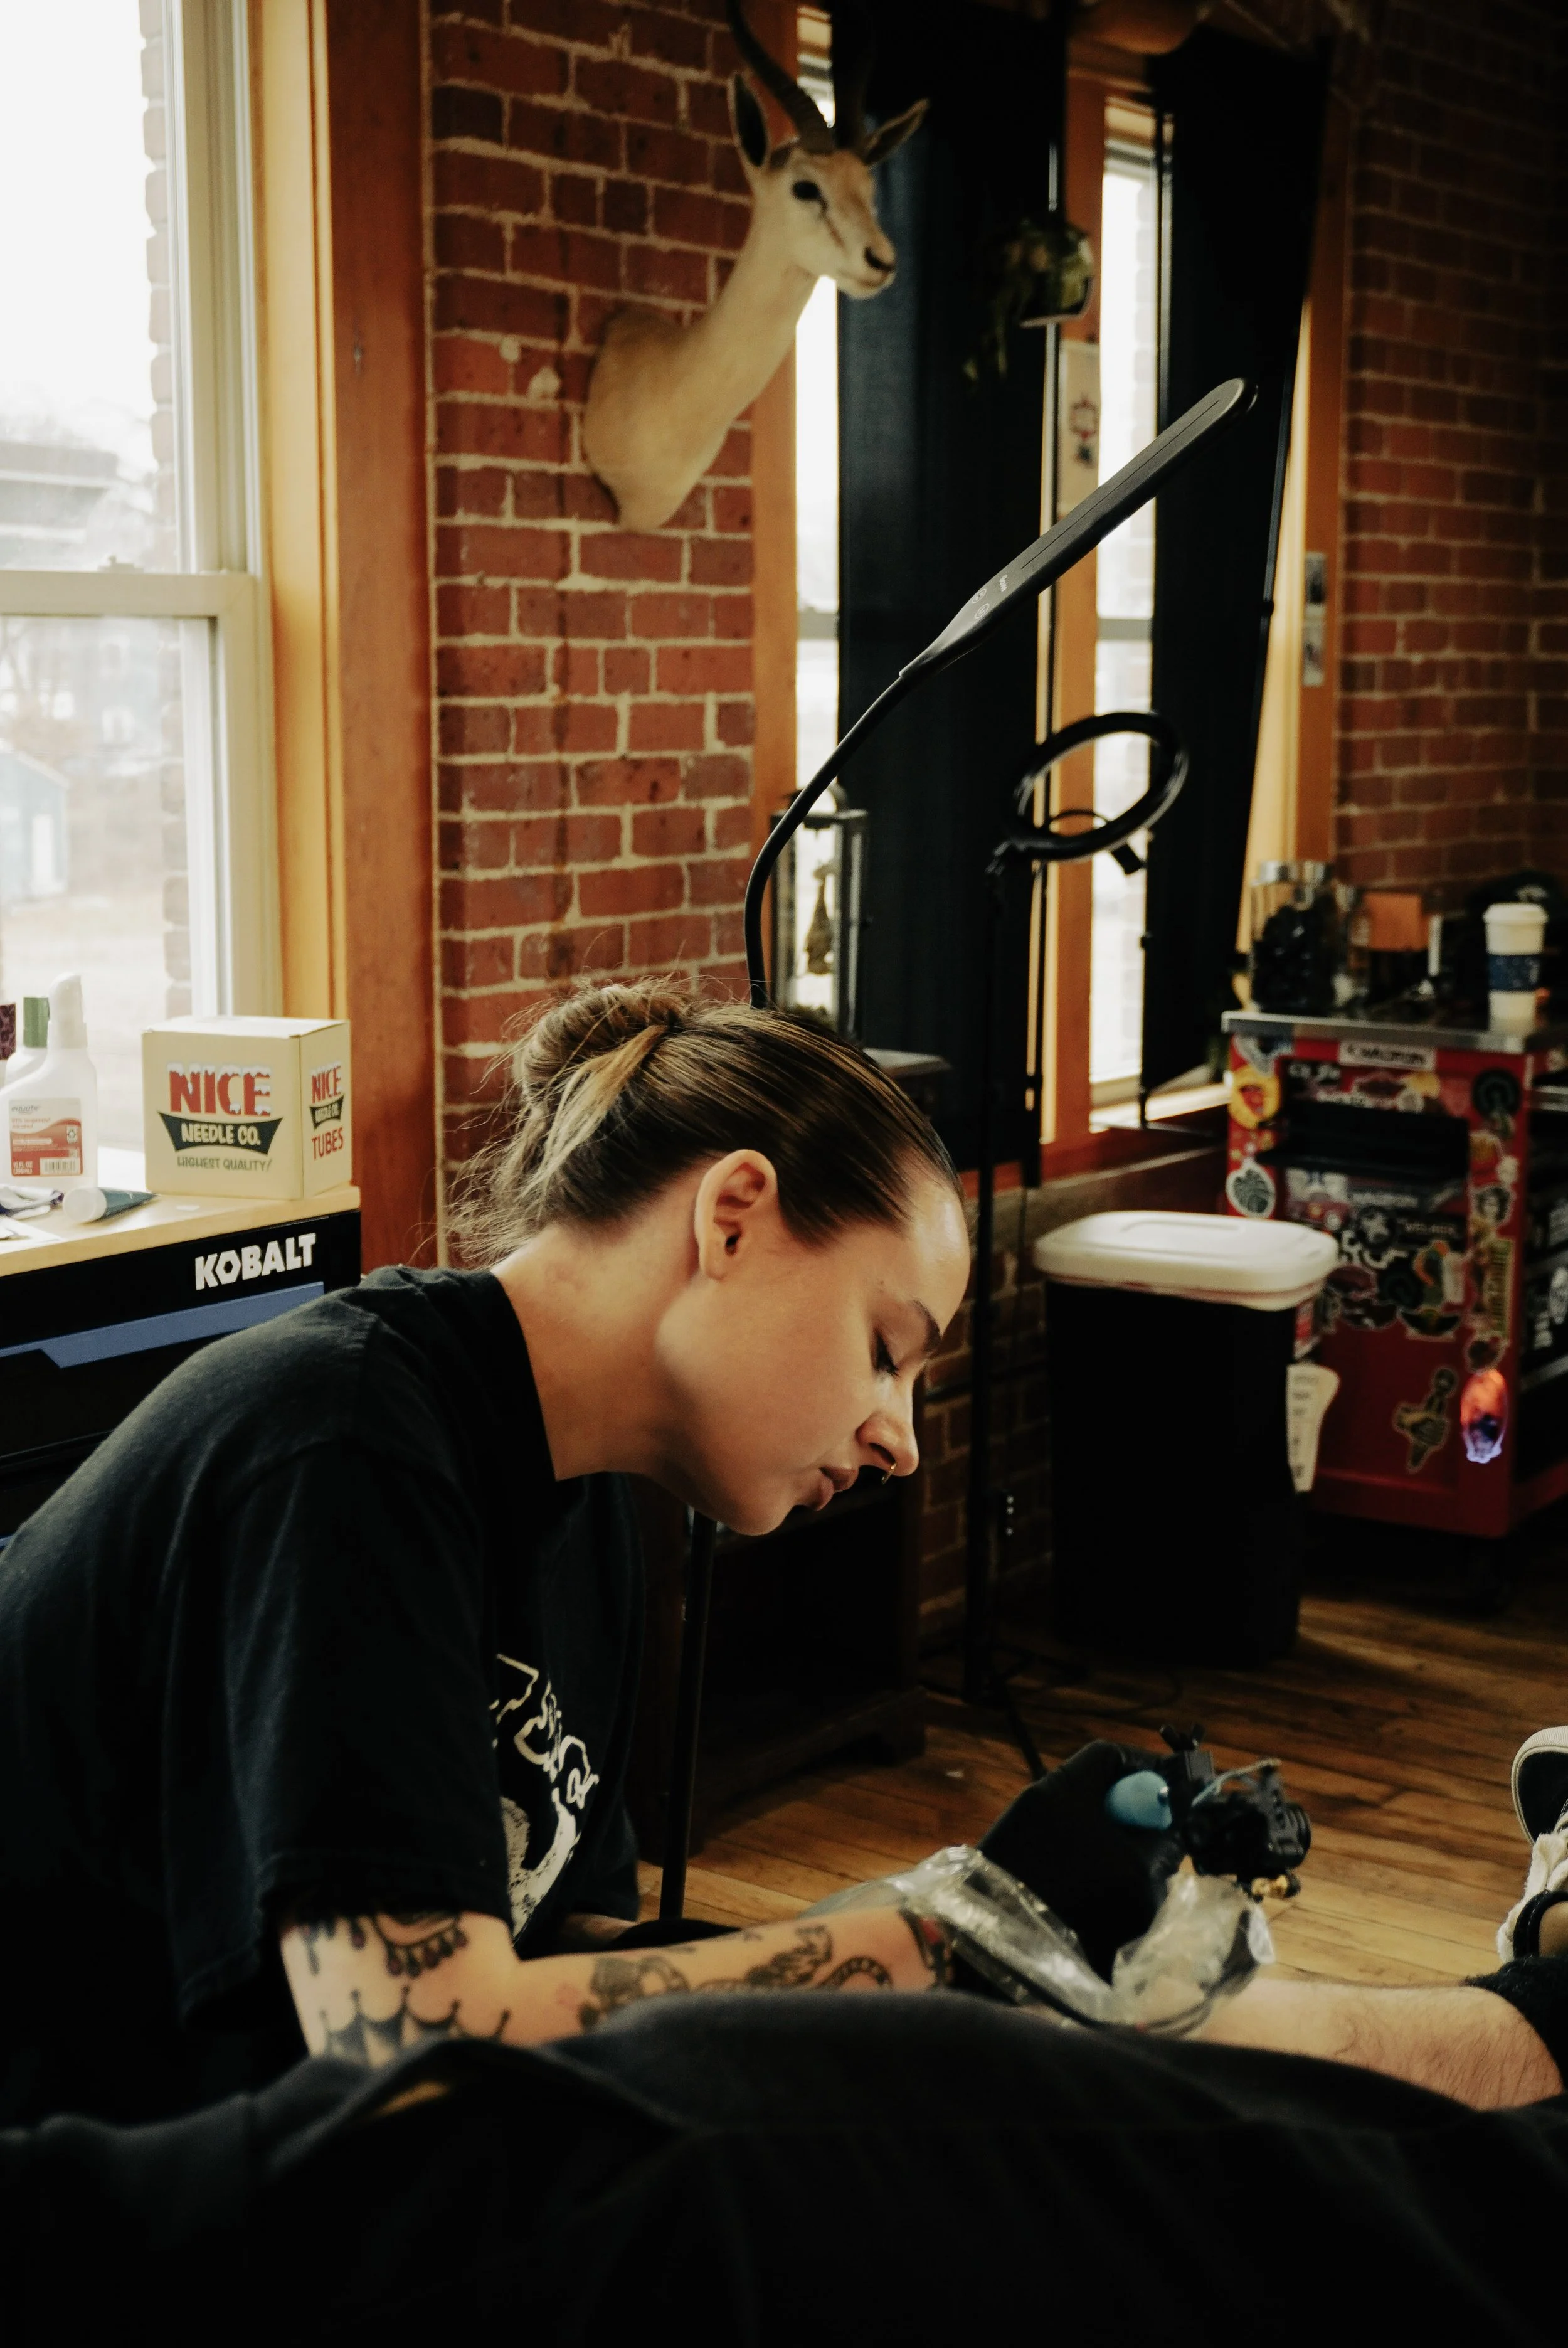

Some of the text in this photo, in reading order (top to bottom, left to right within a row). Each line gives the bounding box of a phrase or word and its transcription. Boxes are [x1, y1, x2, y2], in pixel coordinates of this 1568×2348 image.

[167, 1063, 271, 1116] NICE
[311, 1061, 341, 1104] NICE
[181, 1123, 261, 1145] NEEDLE CO.
[312, 1127, 343, 1159] TUBES
[177, 1156, 220, 1169] HIGHEST
[195, 1233, 316, 1290] KOBALT
